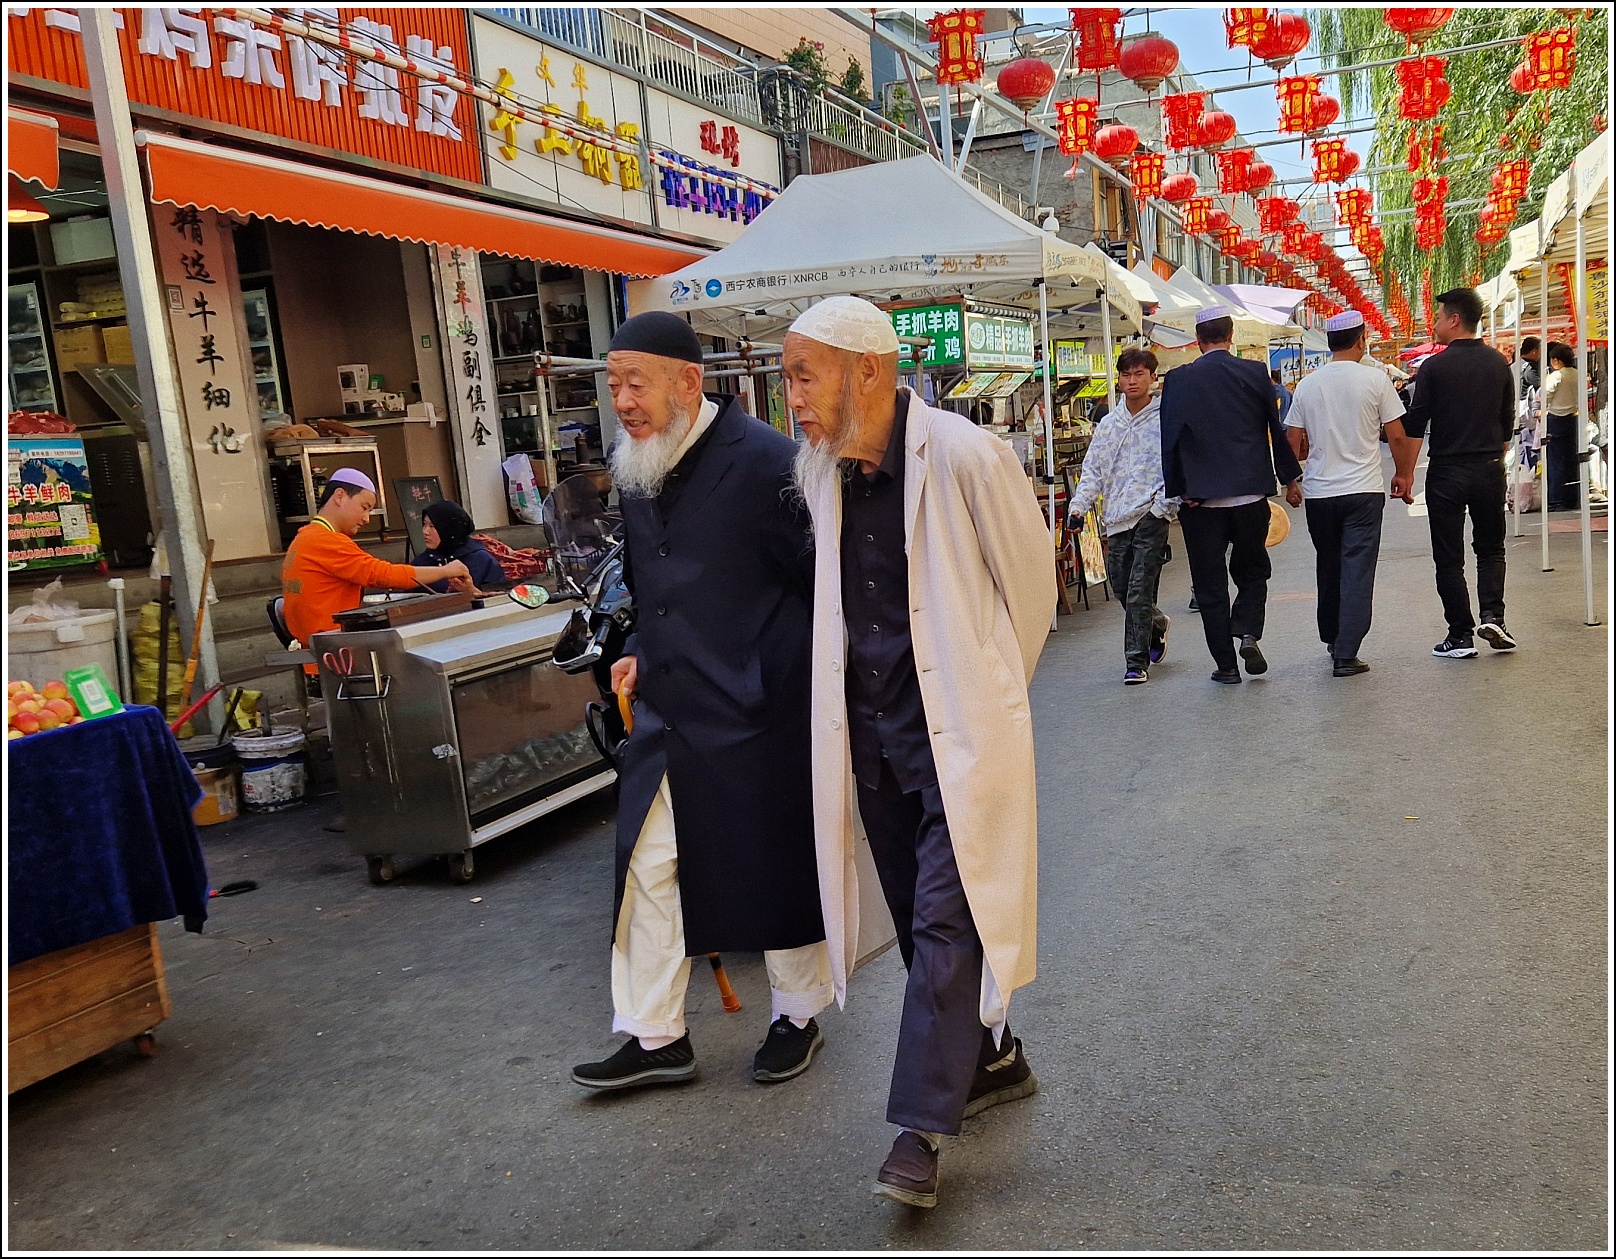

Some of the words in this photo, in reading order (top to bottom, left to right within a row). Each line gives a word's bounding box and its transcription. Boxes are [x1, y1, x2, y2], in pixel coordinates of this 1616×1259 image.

[725, 275, 787, 292] 西宁农商银行
[793, 271, 829, 283] XNRCB
[896, 309, 959, 335] 手抓羊肉
[8, 483, 72, 503] 牛羊鲜肉
